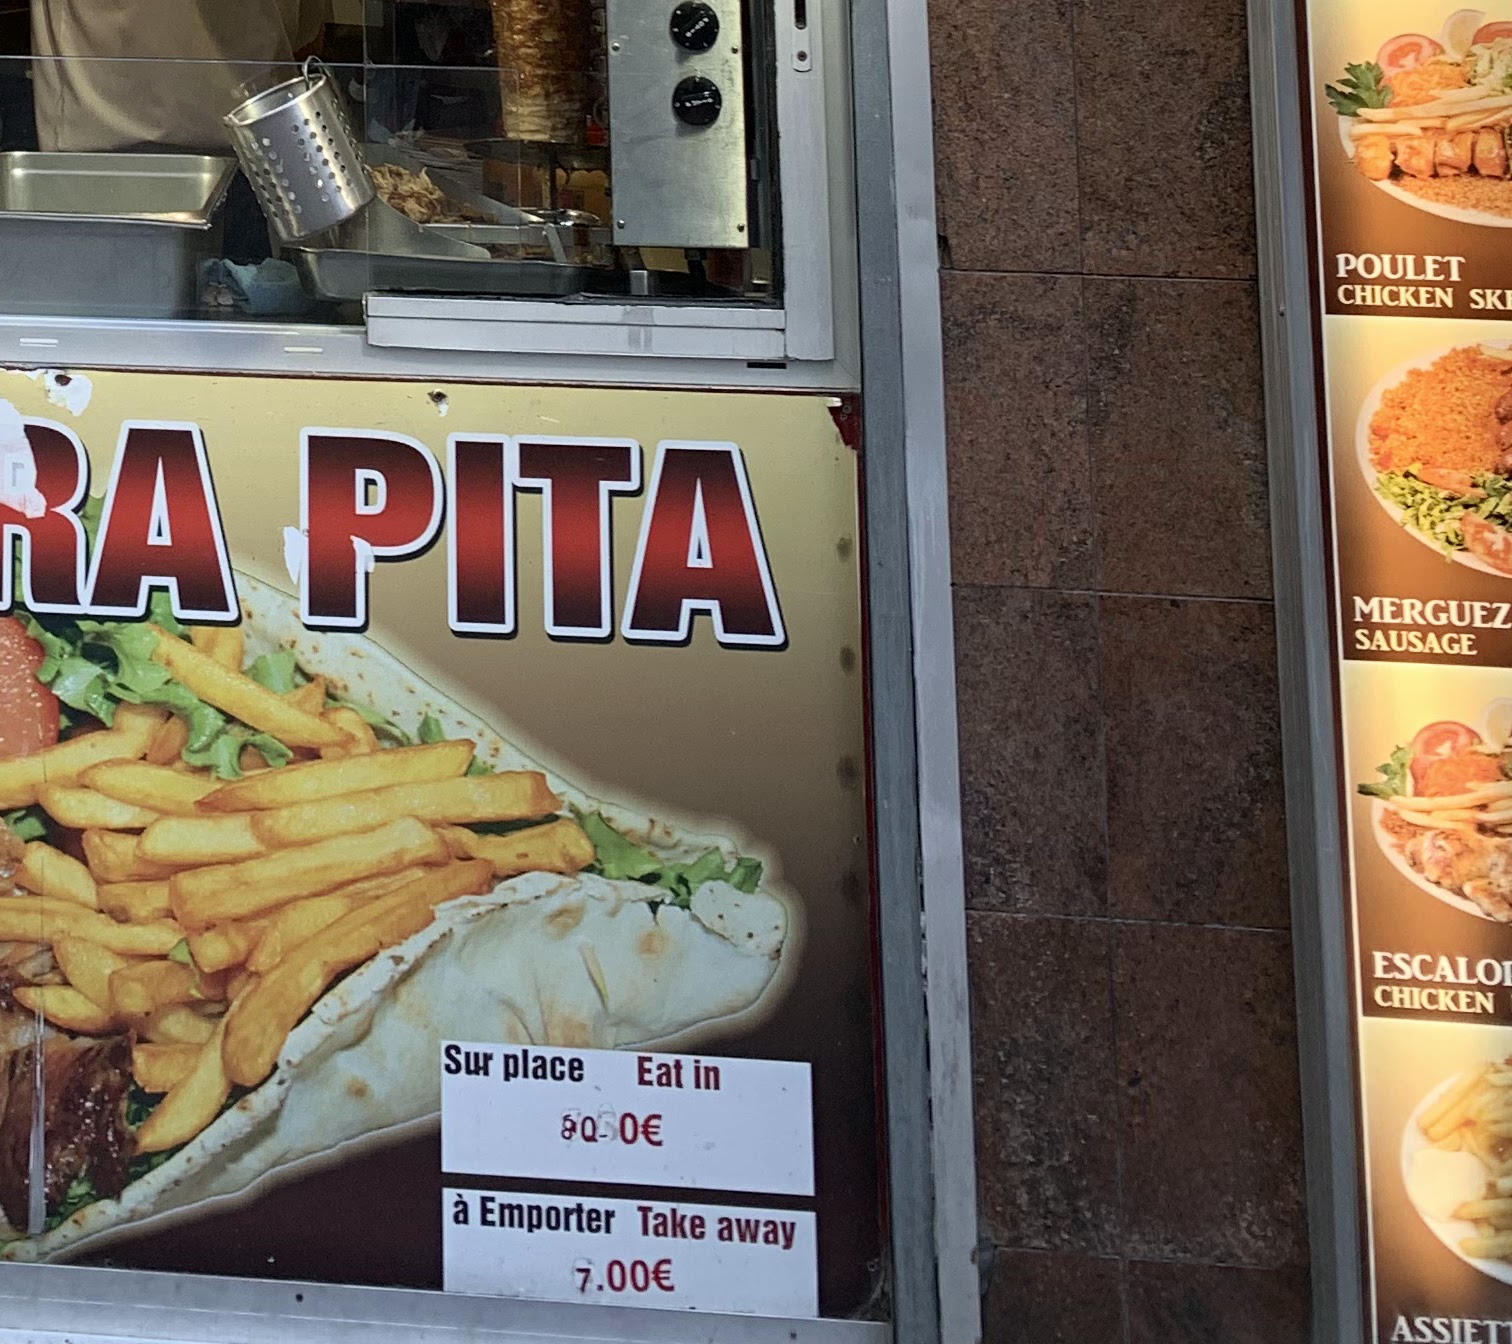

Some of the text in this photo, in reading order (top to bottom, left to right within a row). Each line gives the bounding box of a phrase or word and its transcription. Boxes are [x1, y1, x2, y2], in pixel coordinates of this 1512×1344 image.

[1336, 253, 1466, 281] POULET
[1337, 284, 1454, 308] CHICKEN
[298, 424, 788, 648] PITA
[1353, 595, 1512, 629] MERGUEZ
[1355, 628, 1478, 656] SAUSAGE
[1374, 985, 1496, 1014] CHICKEN
[444, 1044, 721, 1092] Sur place Eat in
[453, 1193, 797, 1251] à Emporter Take away
[575, 1258, 675, 1294] 7.00€
